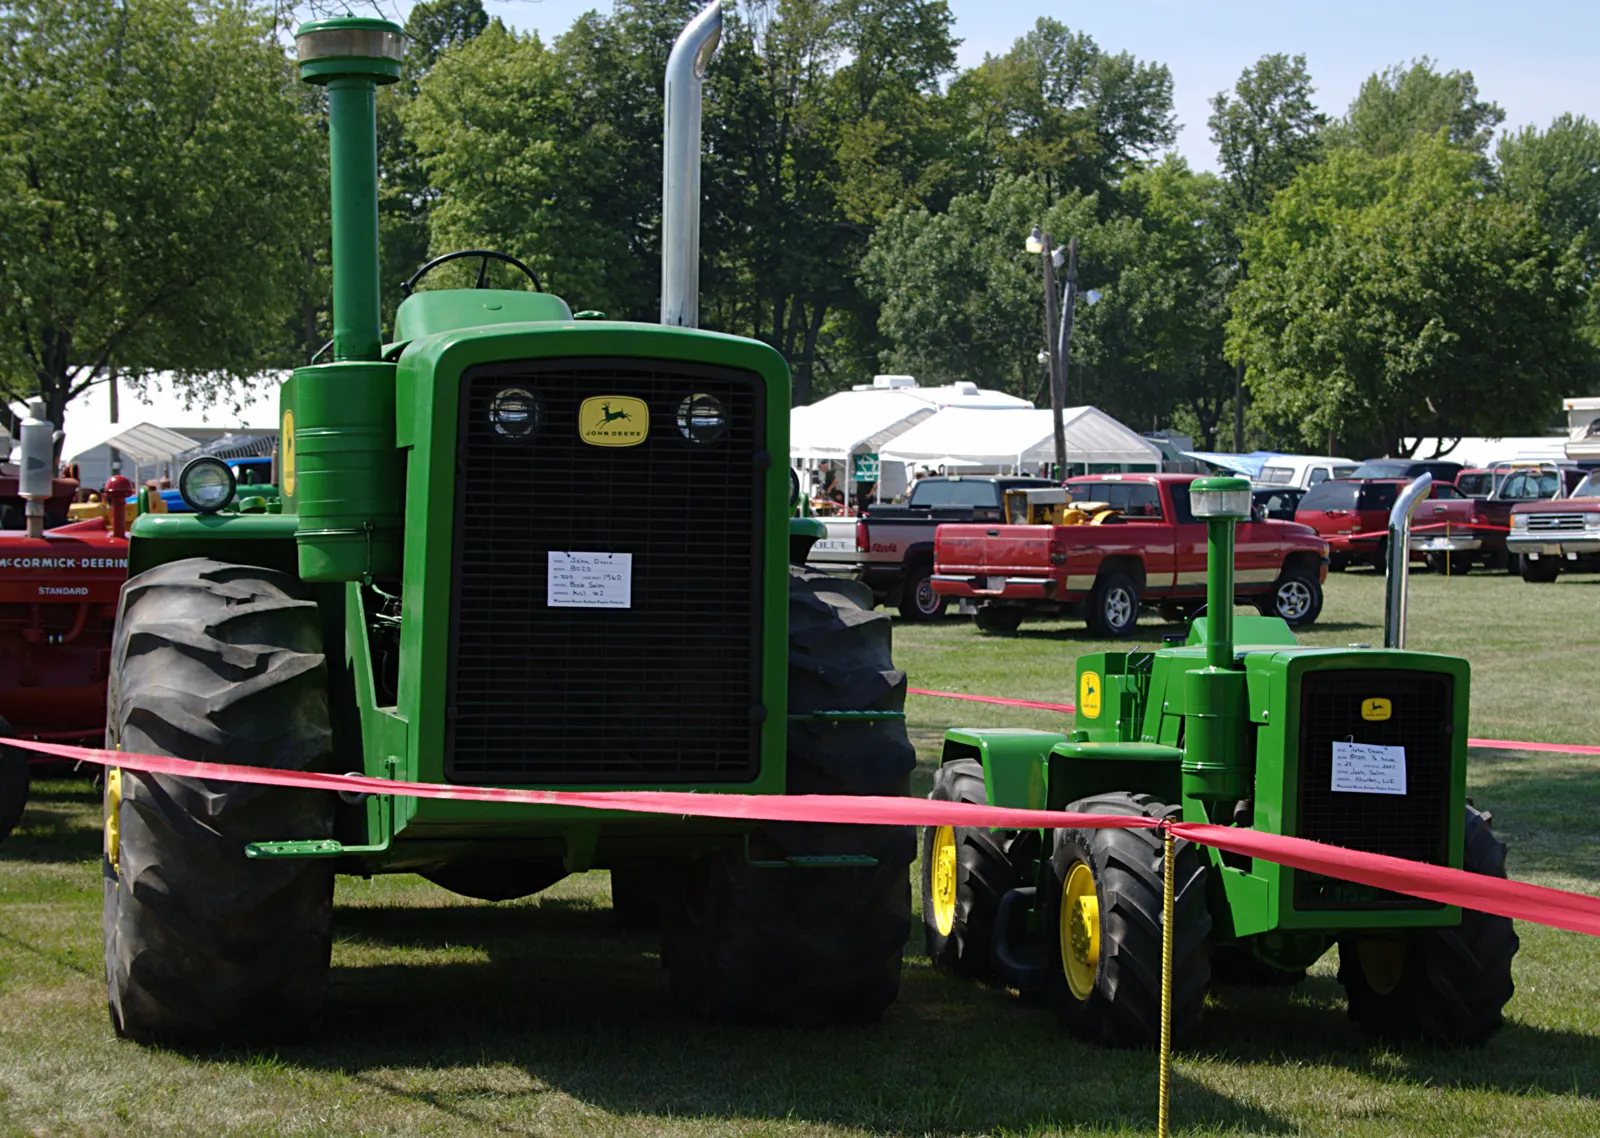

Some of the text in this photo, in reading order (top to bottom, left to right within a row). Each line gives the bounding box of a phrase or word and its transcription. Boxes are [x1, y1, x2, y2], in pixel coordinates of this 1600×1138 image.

[814, 541, 847, 549] OLET
[0, 558, 128, 568] McCORMICK-DEERIN
[38, 587, 88, 595] STANDARD
